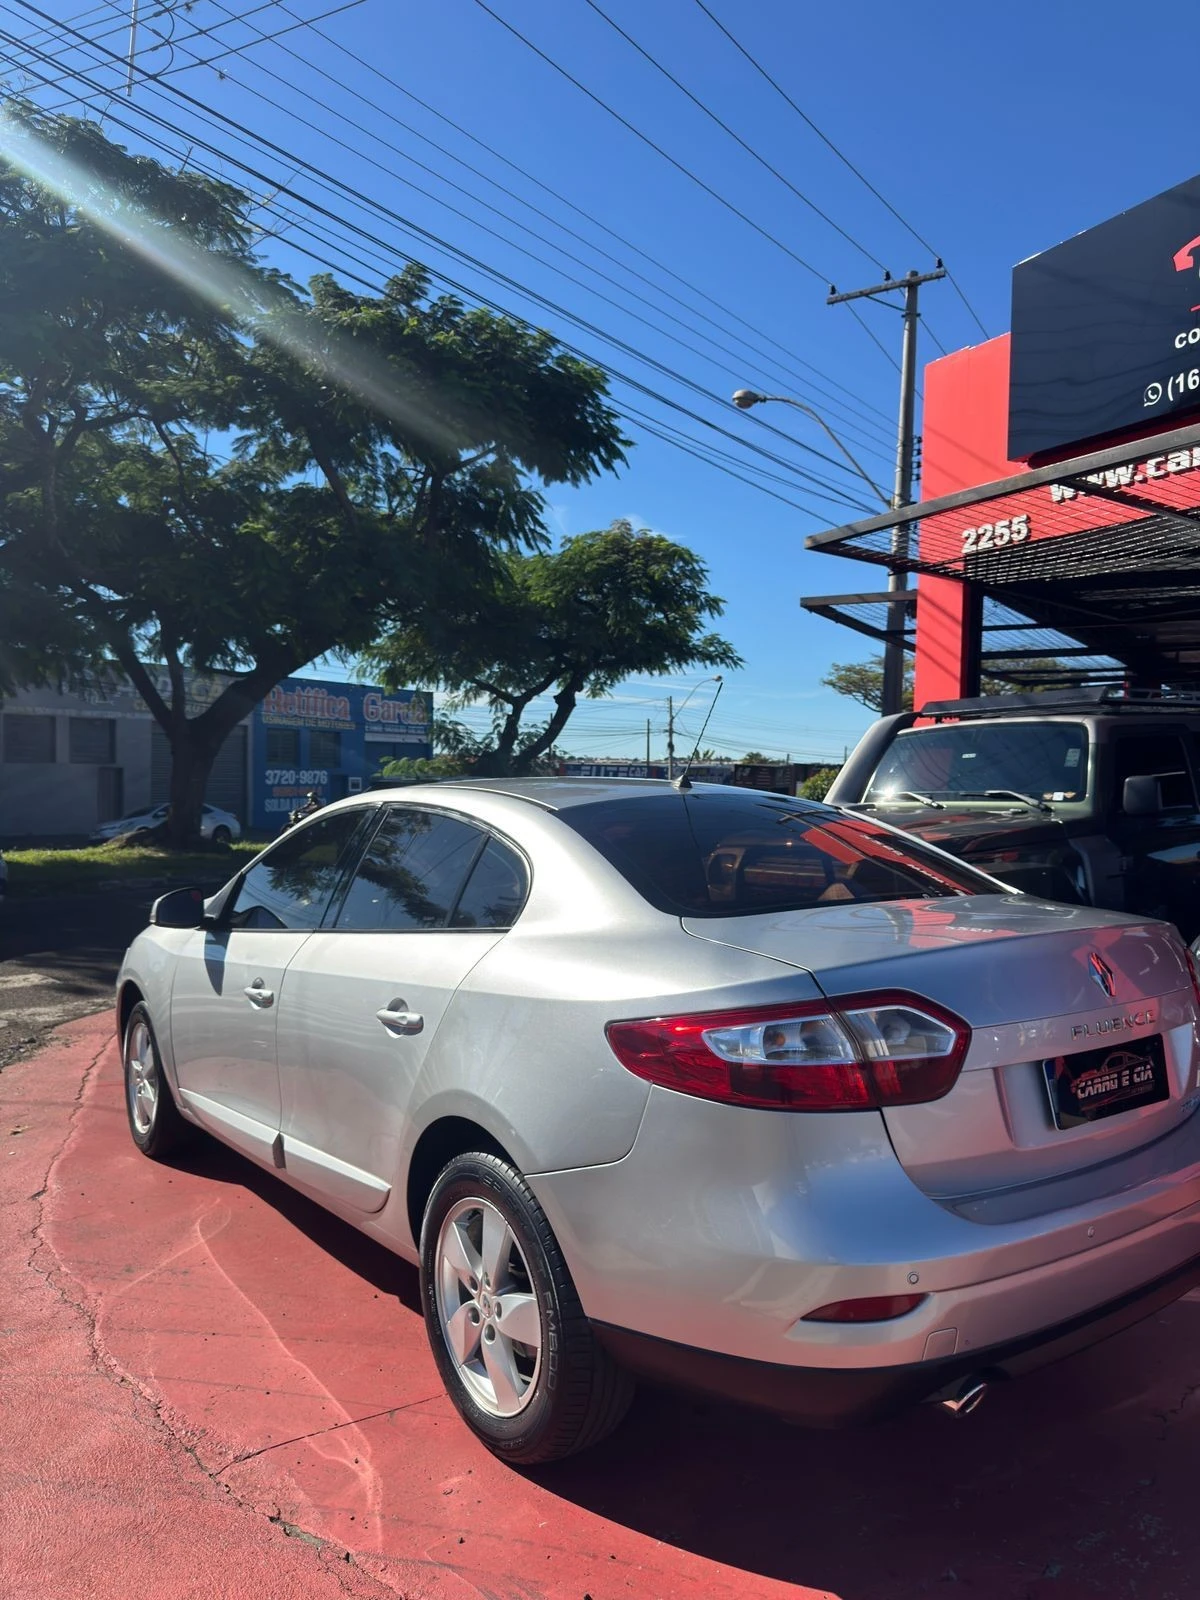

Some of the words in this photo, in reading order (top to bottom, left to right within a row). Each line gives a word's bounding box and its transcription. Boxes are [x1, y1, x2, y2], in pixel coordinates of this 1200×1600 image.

[1167, 368, 1200, 402] (16
[961, 514, 1029, 554] 2255
[264, 769, 328, 785] 3720-9876
[1071, 1009, 1156, 1041] FLUENCE
[1121, 1069, 1130, 1087] E
[1133, 1064, 1153, 1083] CIA
